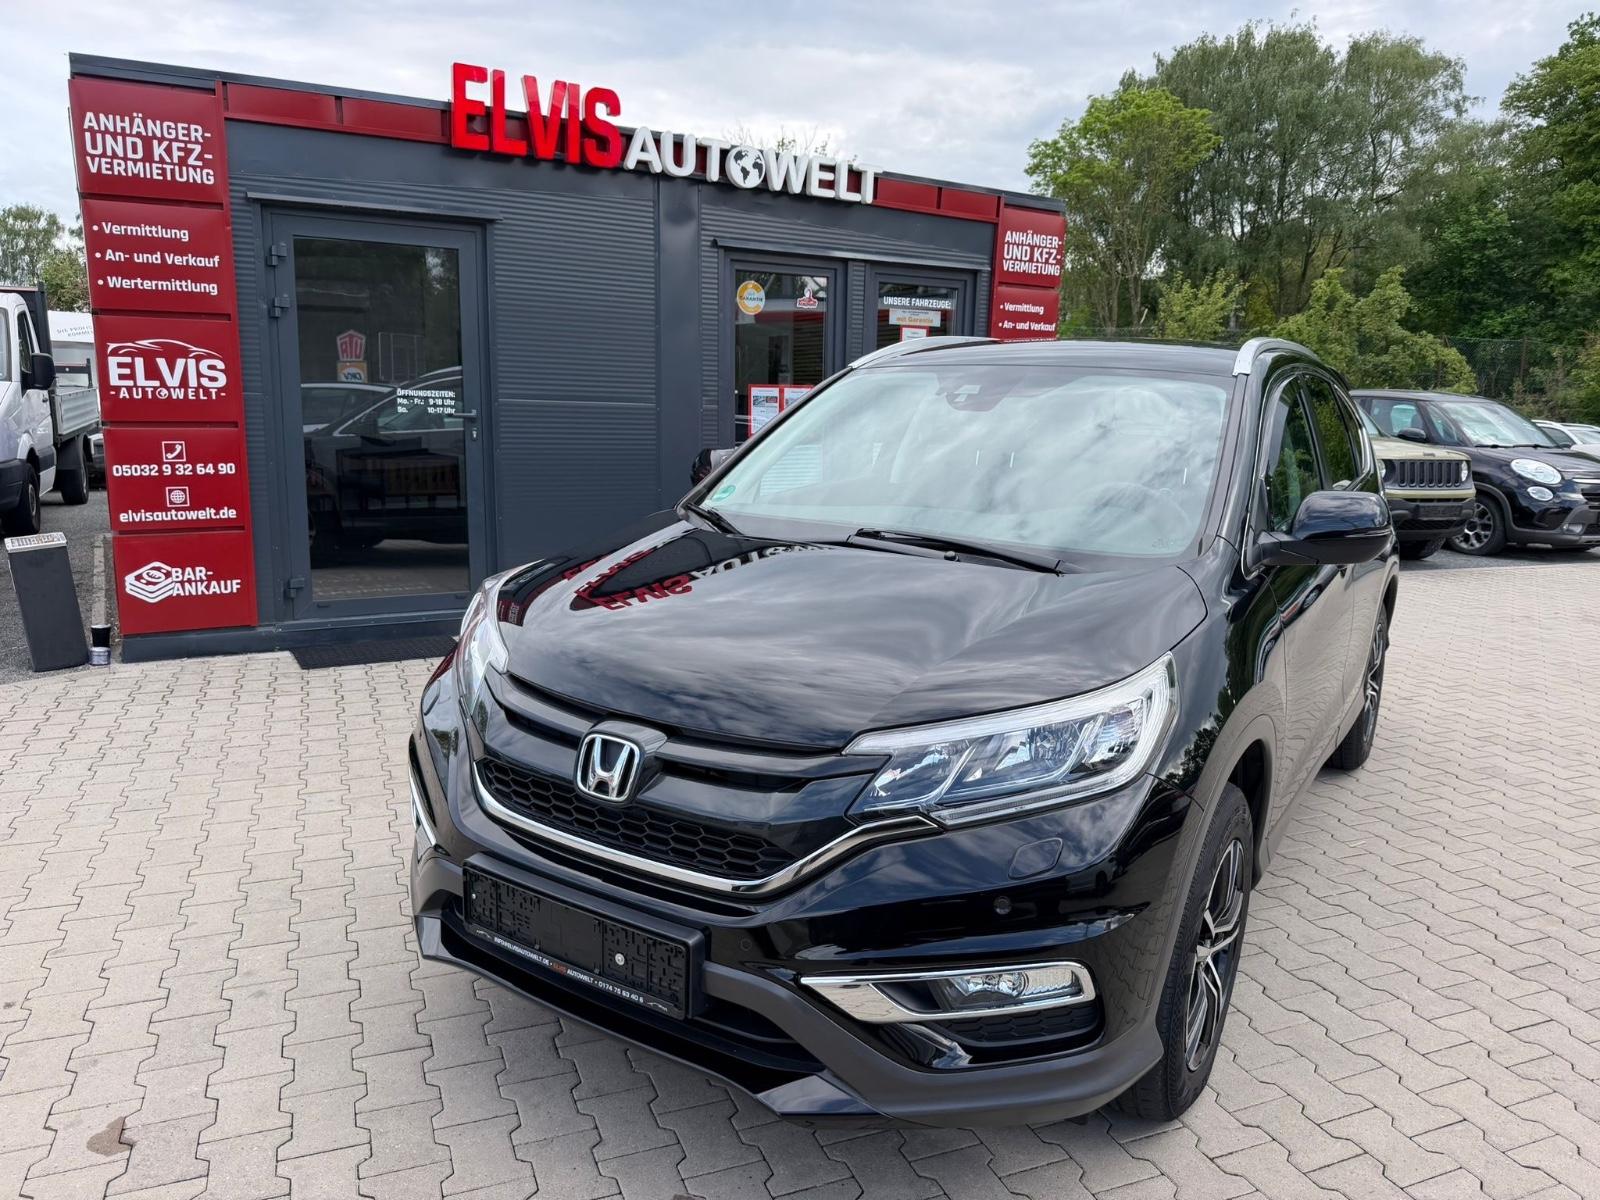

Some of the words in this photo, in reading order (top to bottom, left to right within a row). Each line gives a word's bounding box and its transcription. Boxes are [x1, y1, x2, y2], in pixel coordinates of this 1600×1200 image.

[451, 62, 622, 169] ELVIS
[83, 111, 212, 143] ANHÄNGER-
[85, 131, 144, 160] UND
[152, 140, 213, 167] KFZ-
[86, 156, 215, 185] VERMIETUNG
[102, 221, 189, 242] Vermittlung
[1005, 230, 1062, 248] ANHÄNGER-
[105, 249, 130, 263] An-
[134, 251, 161, 265] und
[165, 254, 220, 268] Verkauf
[1004, 244, 1030, 261] UND
[1033, 248, 1061, 264] KFZ-
[1003, 259, 1060, 276] VERMIETUNG
[106, 275, 218, 296] Wertermittlung
[883, 296, 910, 306] UNSERE
[1004, 302, 1044, 315] Vermittlung
[1003, 319, 1015, 329] An-
[1016, 320, 1030, 331] und
[1030, 322, 1056, 332] Verkauf
[107, 356, 227, 387] ELVIS
[443, 398, 455, 406] Uhr
[112, 465, 160, 477] 05032
[163, 464, 172, 476] 9
[176, 464, 194, 475] 32
[196, 464, 215, 475] 64
[218, 464, 236, 474] 90
[120, 507, 237, 523] elvisautowelt.de
[170, 567, 214, 581] BAR-
[172, 579, 241, 597] ANKAUF
